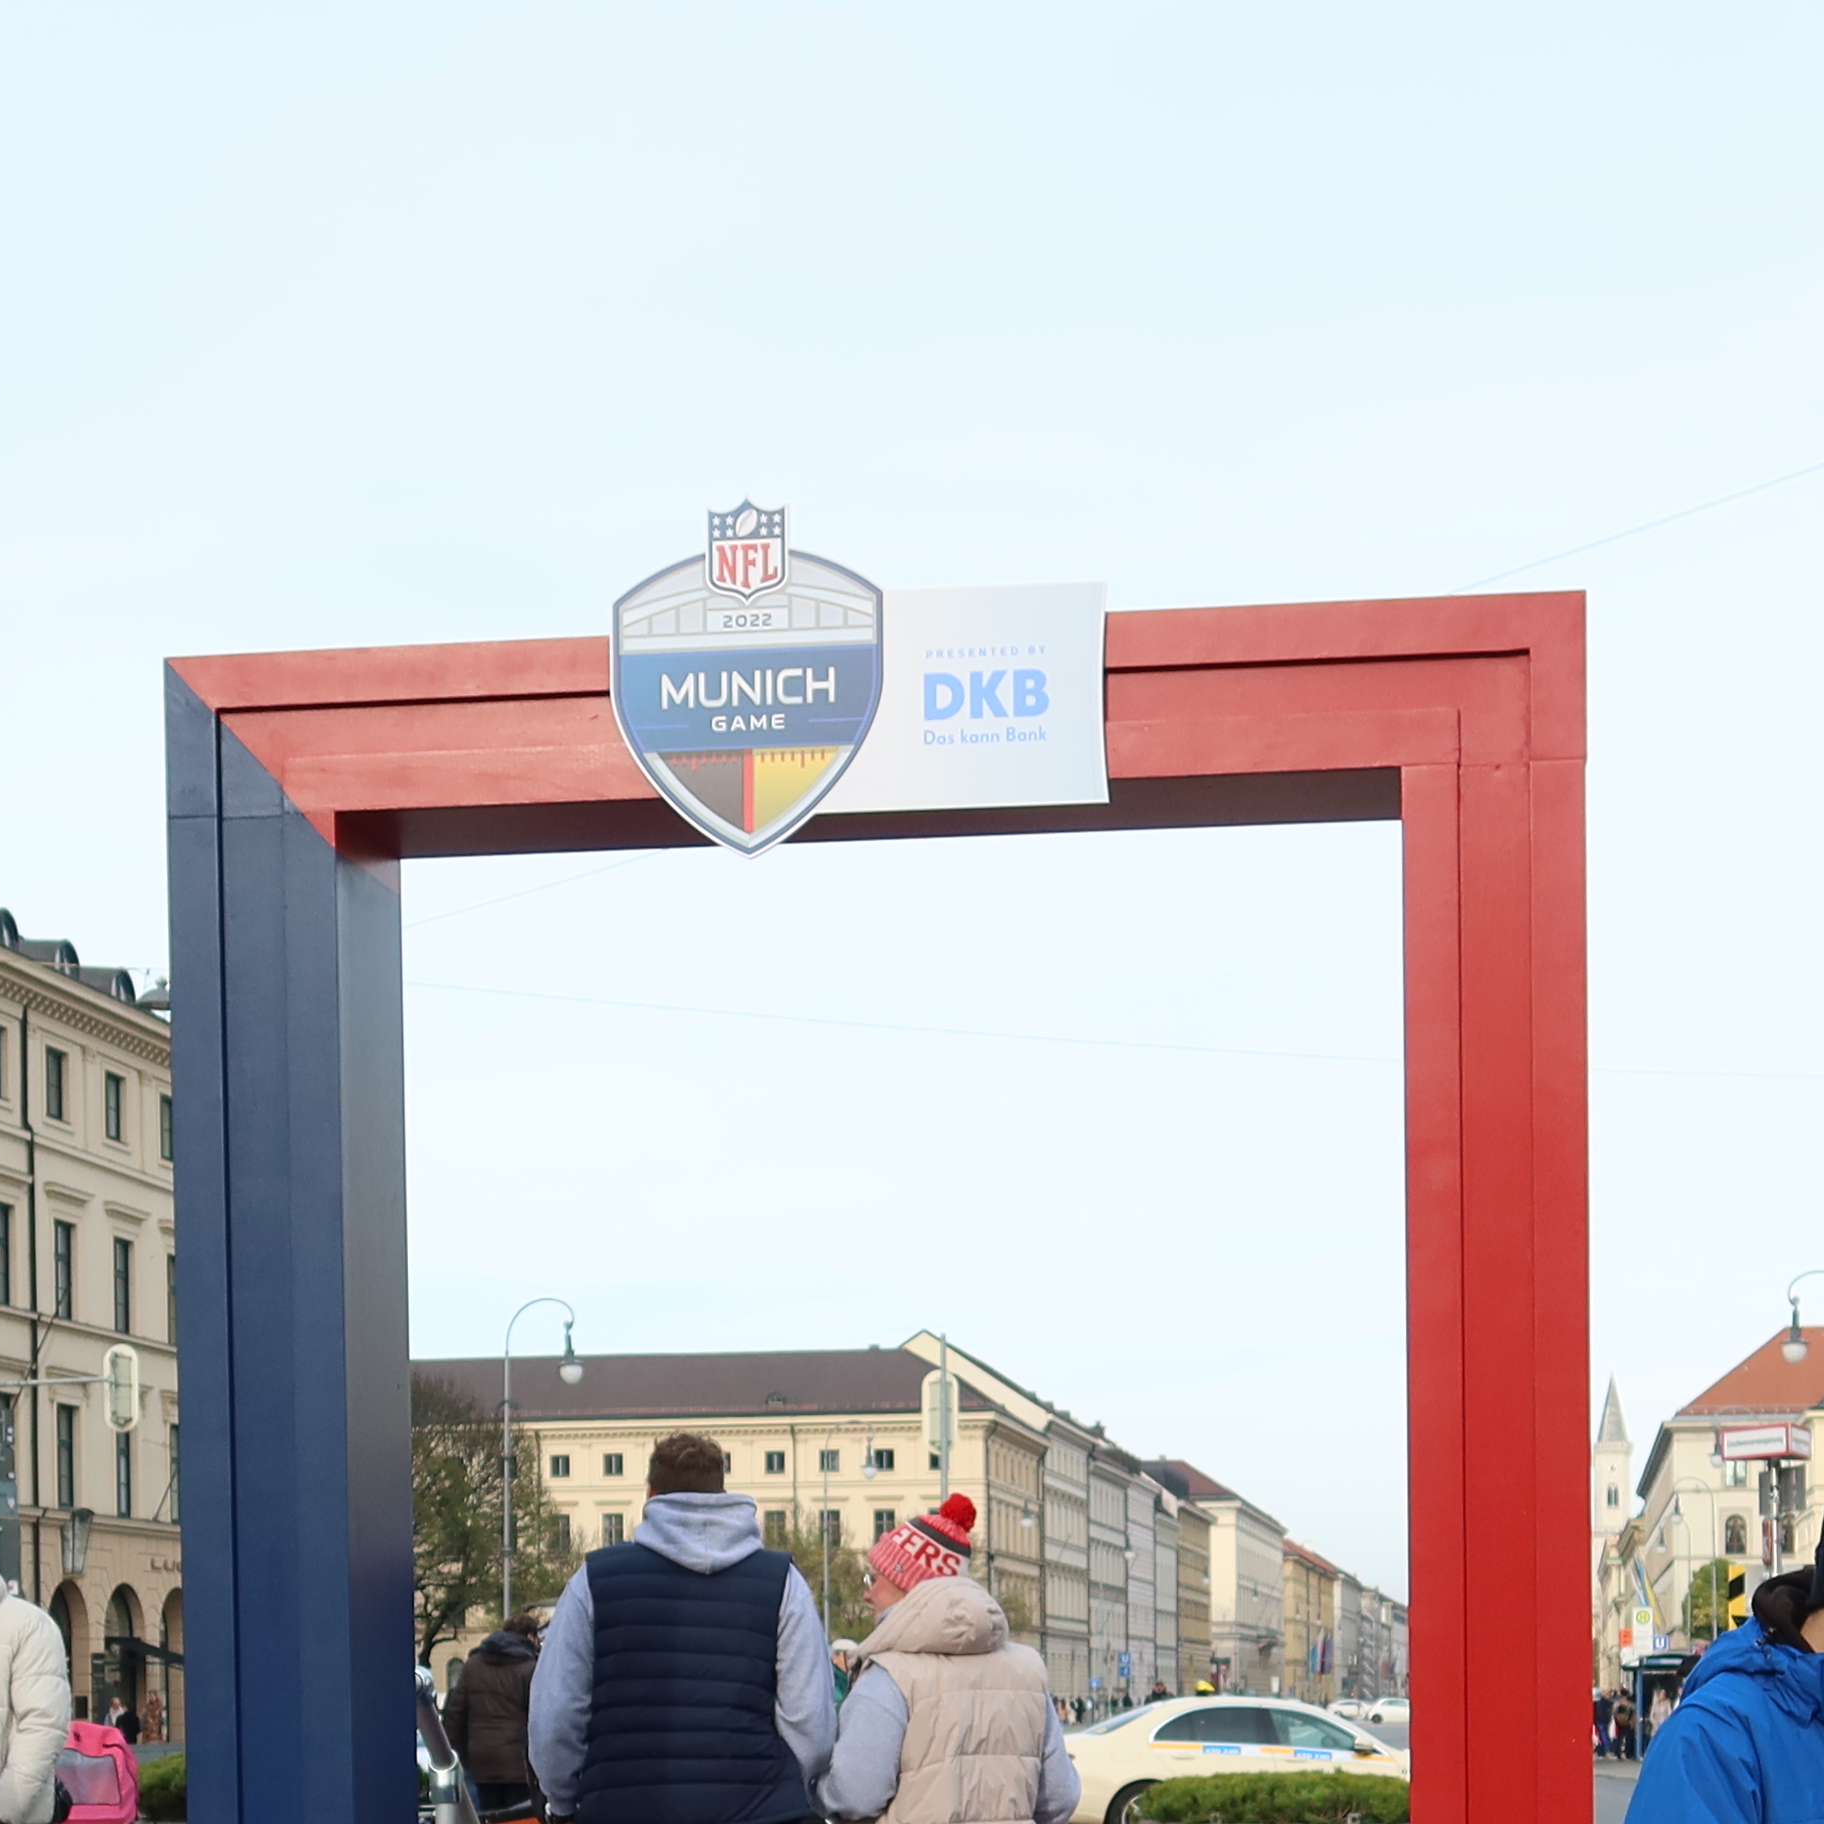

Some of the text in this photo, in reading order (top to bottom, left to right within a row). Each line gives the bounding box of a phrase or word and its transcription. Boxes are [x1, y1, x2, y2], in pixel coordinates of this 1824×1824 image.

[716, 543, 778, 586] NFL
[722, 611, 772, 630] 2022
[924, 644, 1047, 659] PRESENTED BY
[660, 667, 836, 712] MUNICH
[923, 669, 1050, 721] DKB
[711, 713, 787, 732] GAME
[923, 725, 1047, 746] Das kann Bank
